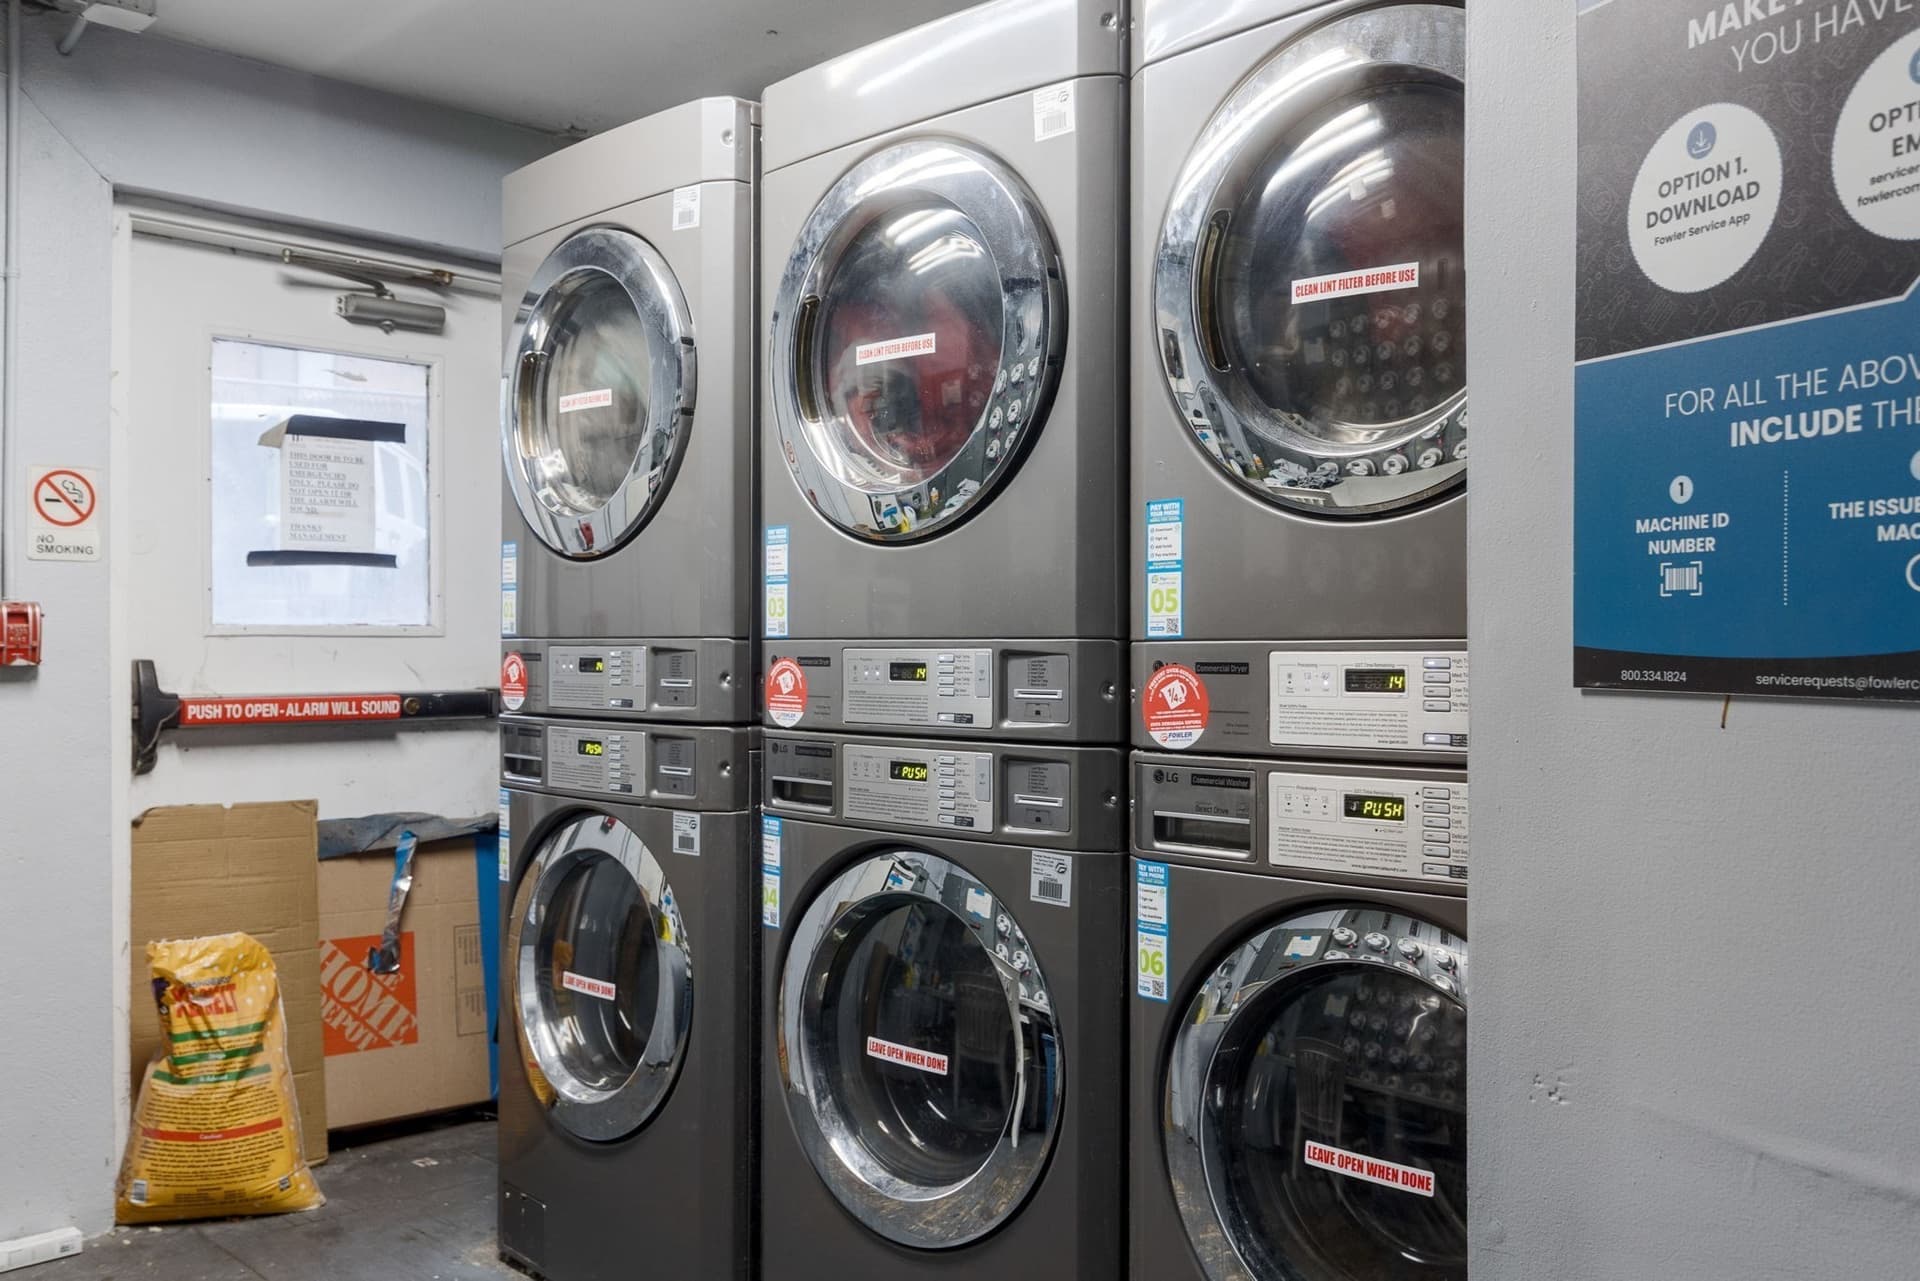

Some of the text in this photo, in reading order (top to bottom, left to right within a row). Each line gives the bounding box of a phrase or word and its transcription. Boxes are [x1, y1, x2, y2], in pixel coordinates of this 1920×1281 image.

[1731, 19, 1800, 72] YOU
[1658, 156, 1748, 198] OPTION 1.
[1646, 180, 1760, 229] DOWNLOAD
[1654, 213, 1751, 246] Fowler Service App
[1295, 268, 1416, 297] CLEAN LINT FILTER BEFORE USE
[1665, 387, 1715, 418] FOR
[1723, 378, 1768, 410] ALL
[1775, 367, 1829, 400] THE
[1730, 404, 1863, 448] INCLUDE
[1678, 482, 1685, 496] 1
[1828, 501, 1865, 519] THE
[1636, 513, 1730, 534] MACHINE ID
[36, 535, 55, 543] NO
[1648, 537, 1716, 555] NUMBER
[36, 544, 94, 555] SMOKING
[767, 598, 785, 618] 03
[1151, 588, 1178, 613] 05
[915, 668, 926, 679] 14
[1387, 675, 1403, 689] 14
[1620, 670, 1687, 683] 800.334.1824
[187, 704, 222, 719] PUSH
[223, 704, 241, 718] TO
[331, 701, 359, 715] WILL
[361, 700, 400, 714] SOUND
[902, 766, 928, 779] PUSH
[1165, 771, 1179, 783] LG
[1362, 801, 1403, 817] PUSH
[1139, 949, 1165, 975] 06
[320, 940, 418, 1047] HOME
[869, 1039, 946, 1071] LEAVE OPEN WHEN DONE
[1307, 1144, 1432, 1192] LEAVE OPEN WHEN DONE
